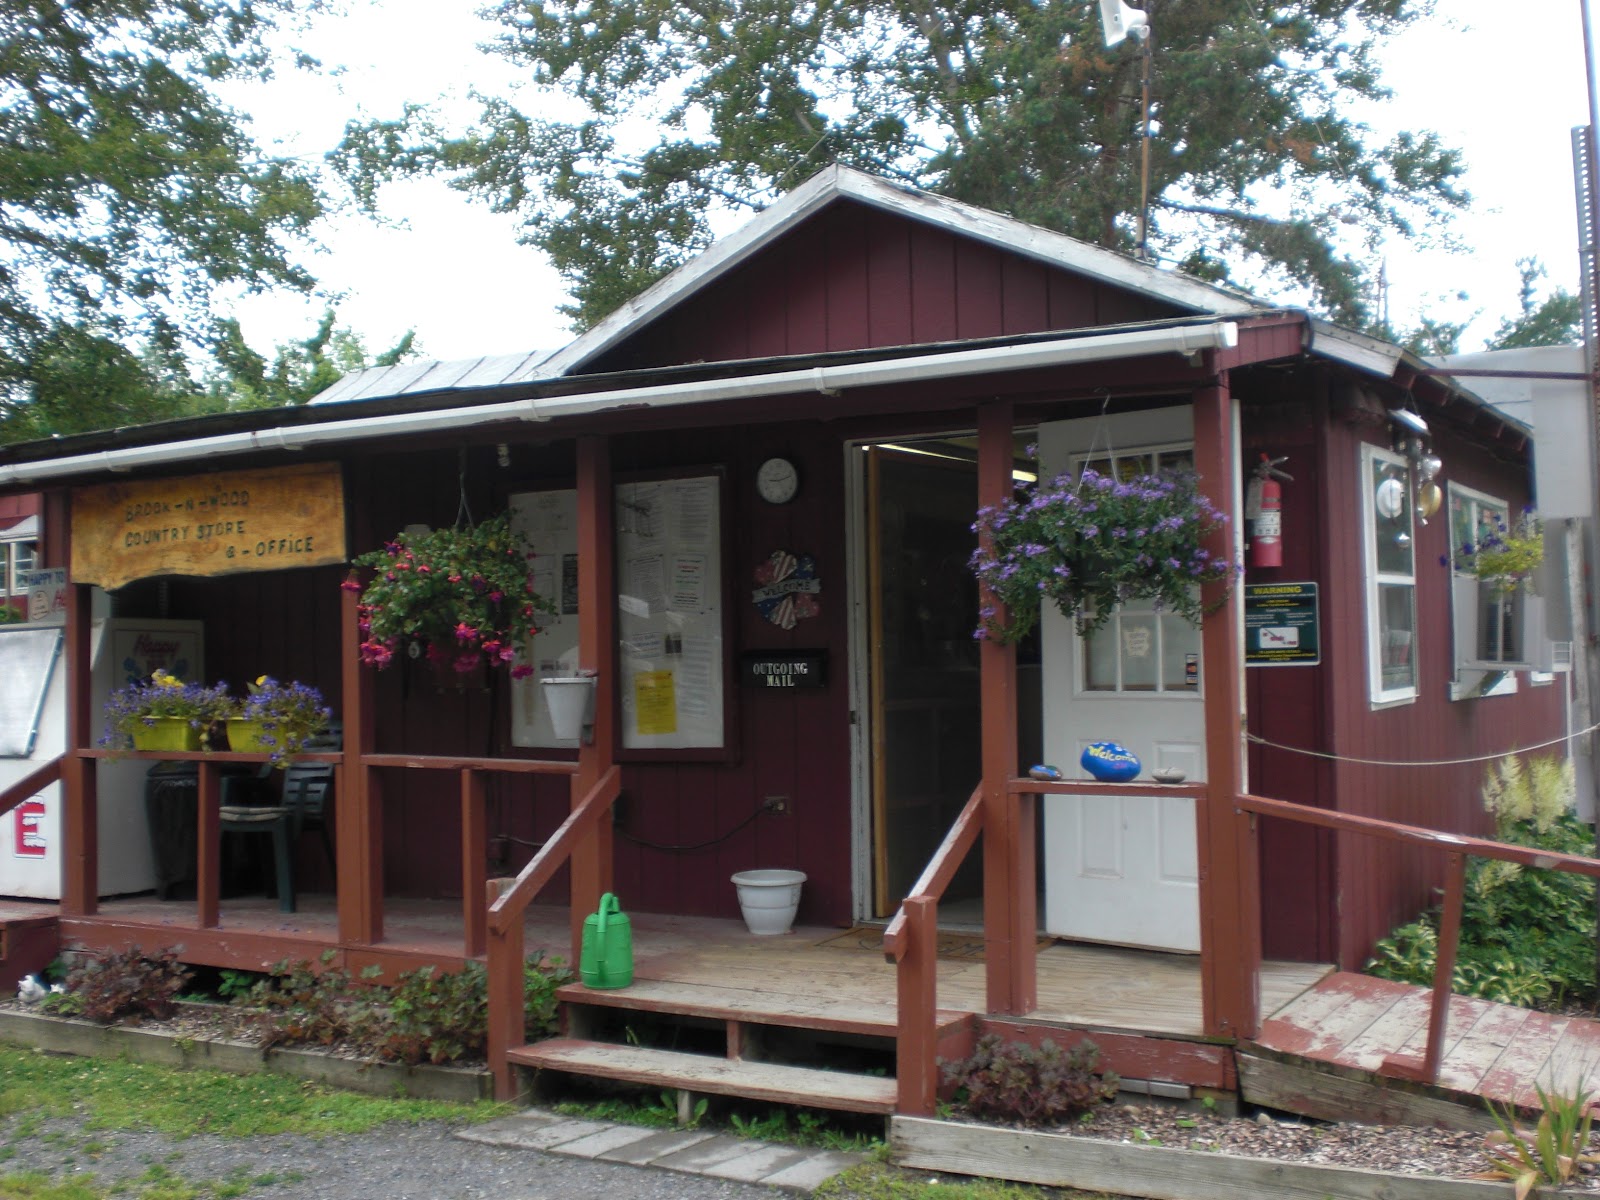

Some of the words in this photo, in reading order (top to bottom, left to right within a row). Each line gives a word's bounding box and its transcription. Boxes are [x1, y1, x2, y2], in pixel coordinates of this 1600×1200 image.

[124, 525, 190, 548] COUNTRY
[196, 520, 247, 540] STORE
[762, 580, 811, 596] WELCOME
[1253, 586, 1302, 595] WARNING
[752, 662, 808, 675] OUTGOING
[766, 674, 795, 687] MAIL
[1087, 745, 1138, 764] Welcome
